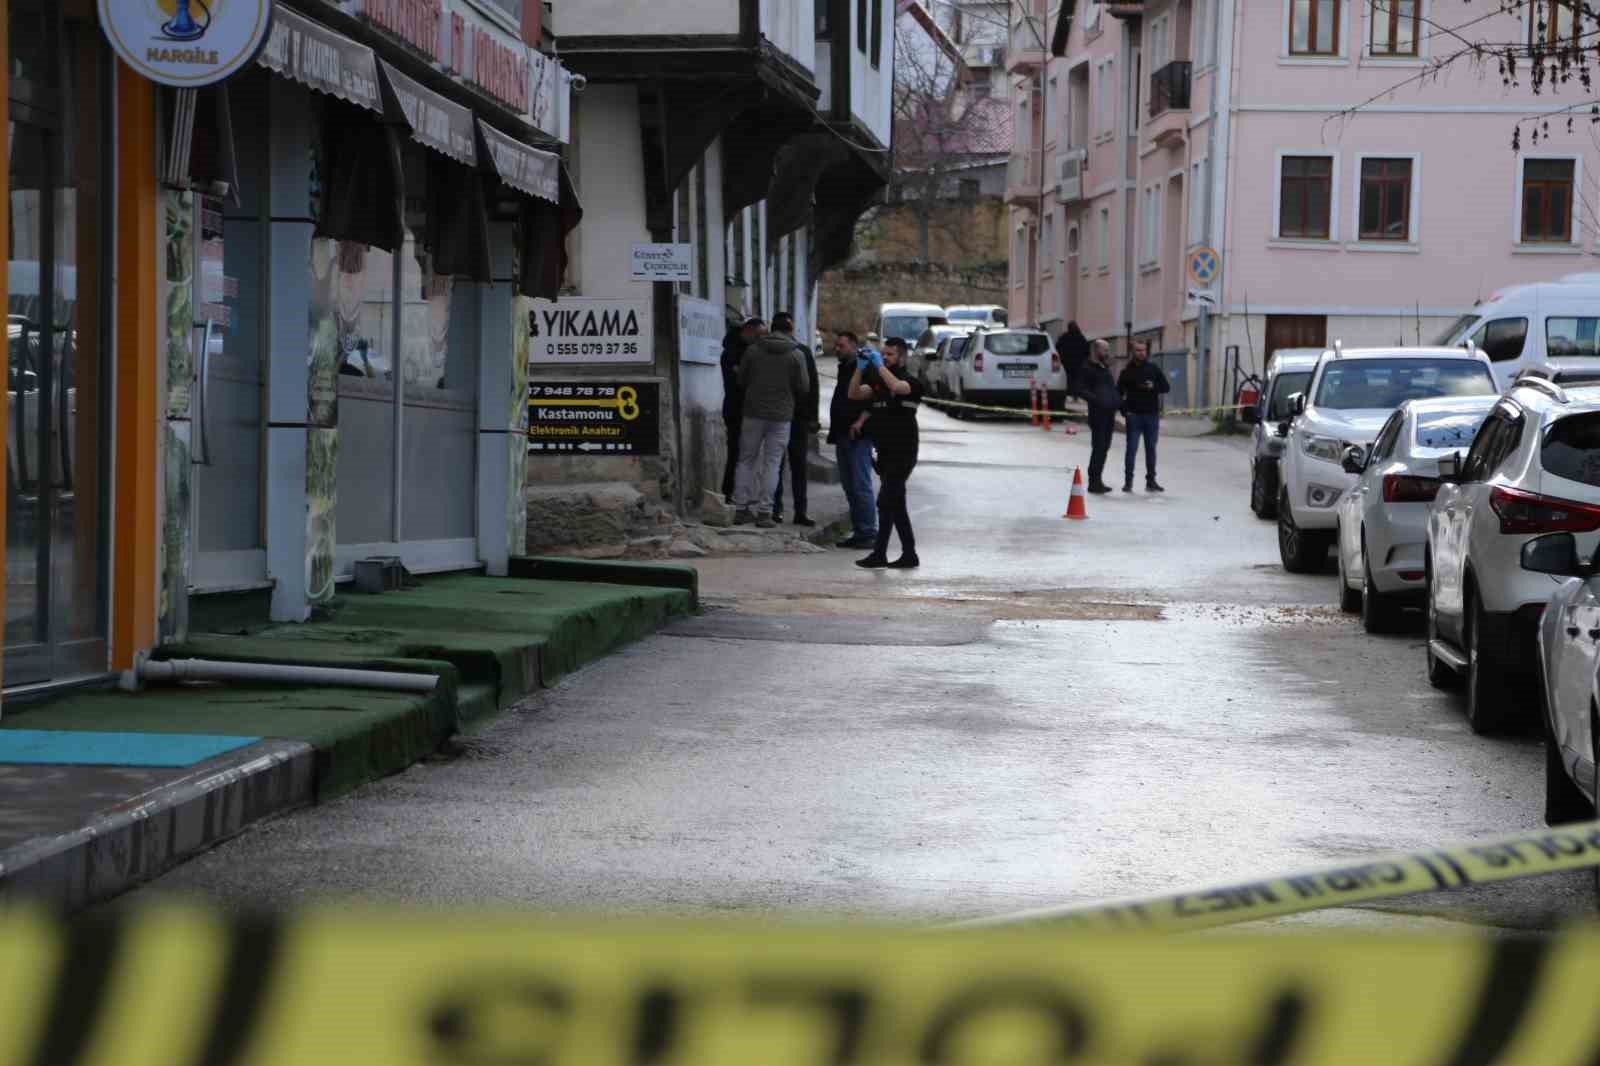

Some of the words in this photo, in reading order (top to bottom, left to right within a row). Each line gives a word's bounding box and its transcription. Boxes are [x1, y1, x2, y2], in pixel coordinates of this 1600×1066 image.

[146, 47, 219, 65] HARGİLE
[543, 309, 640, 337] YIKAMA
[546, 343, 555, 355] 0
[557, 343, 578, 355] 555
[581, 343, 603, 355] 079
[605, 343, 620, 355] 37
[622, 342, 638, 355] 36
[543, 387, 573, 396] 948
[575, 387, 594, 396] 78
[597, 387, 615, 396] 78
[538, 408, 614, 420] Kastamonu
[530, 425, 580, 436] Elektronik
[582, 425, 621, 436] Anahtar
